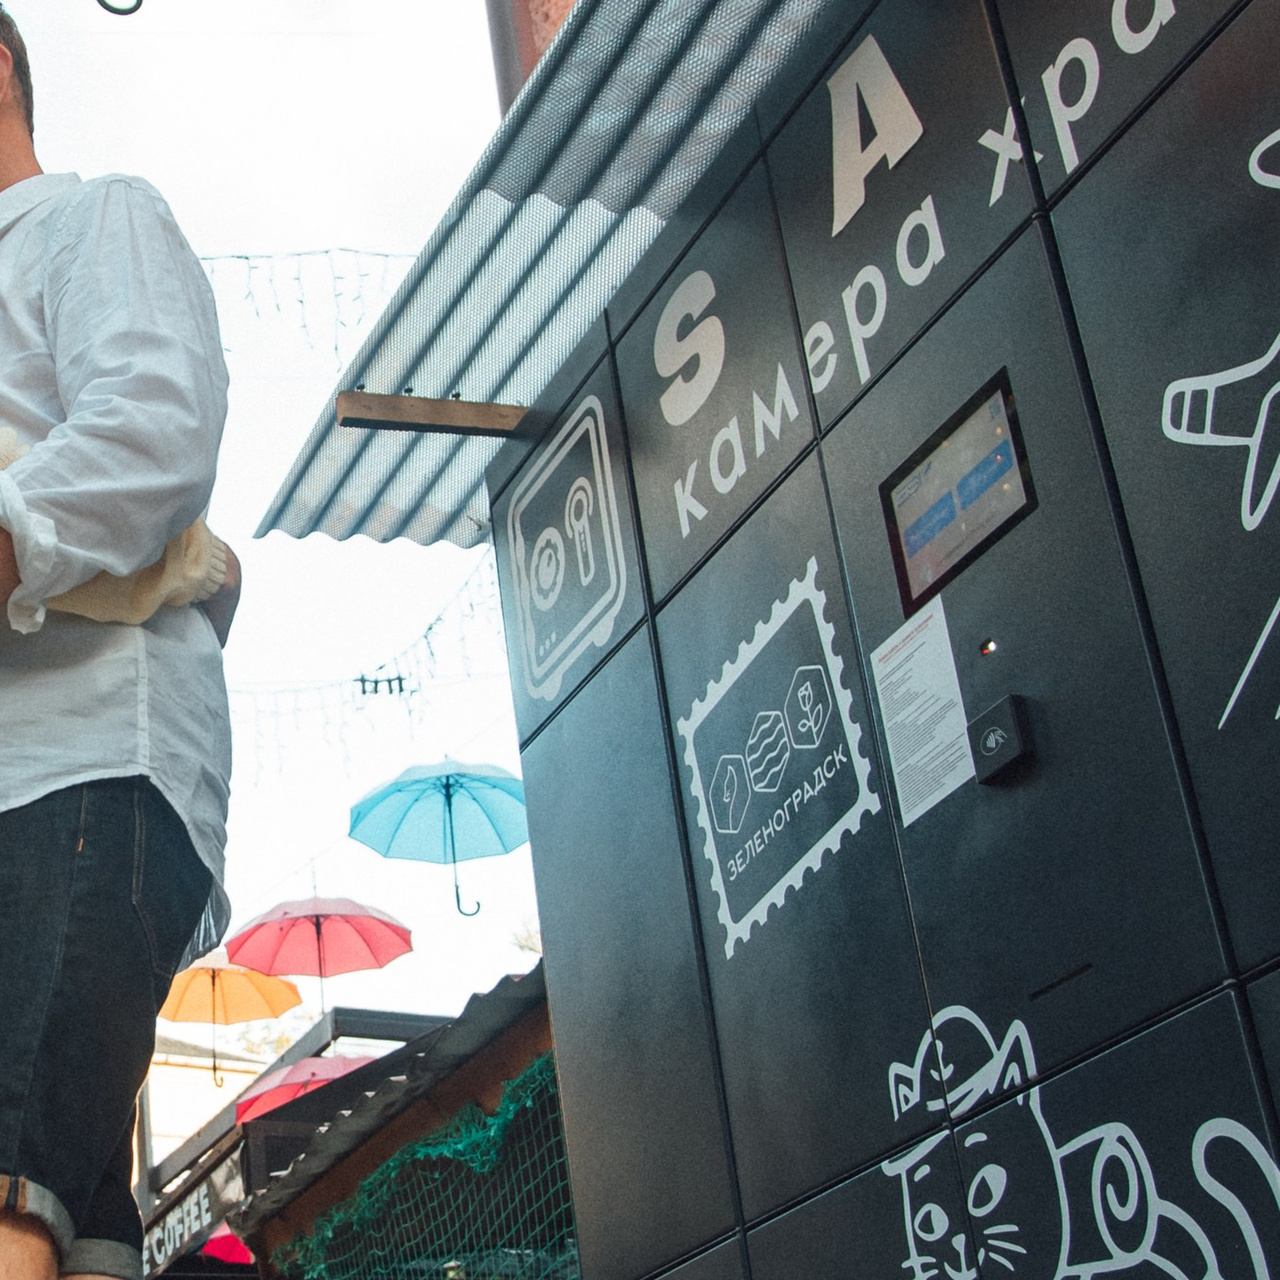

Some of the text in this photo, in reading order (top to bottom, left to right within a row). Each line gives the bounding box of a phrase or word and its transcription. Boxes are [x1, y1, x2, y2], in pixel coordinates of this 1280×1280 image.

[674, 194, 945, 538] камера
[727, 743, 848, 881] ЗЕЛЕНОГРАДСК
[150, 1182, 212, 1265] COFFEE
